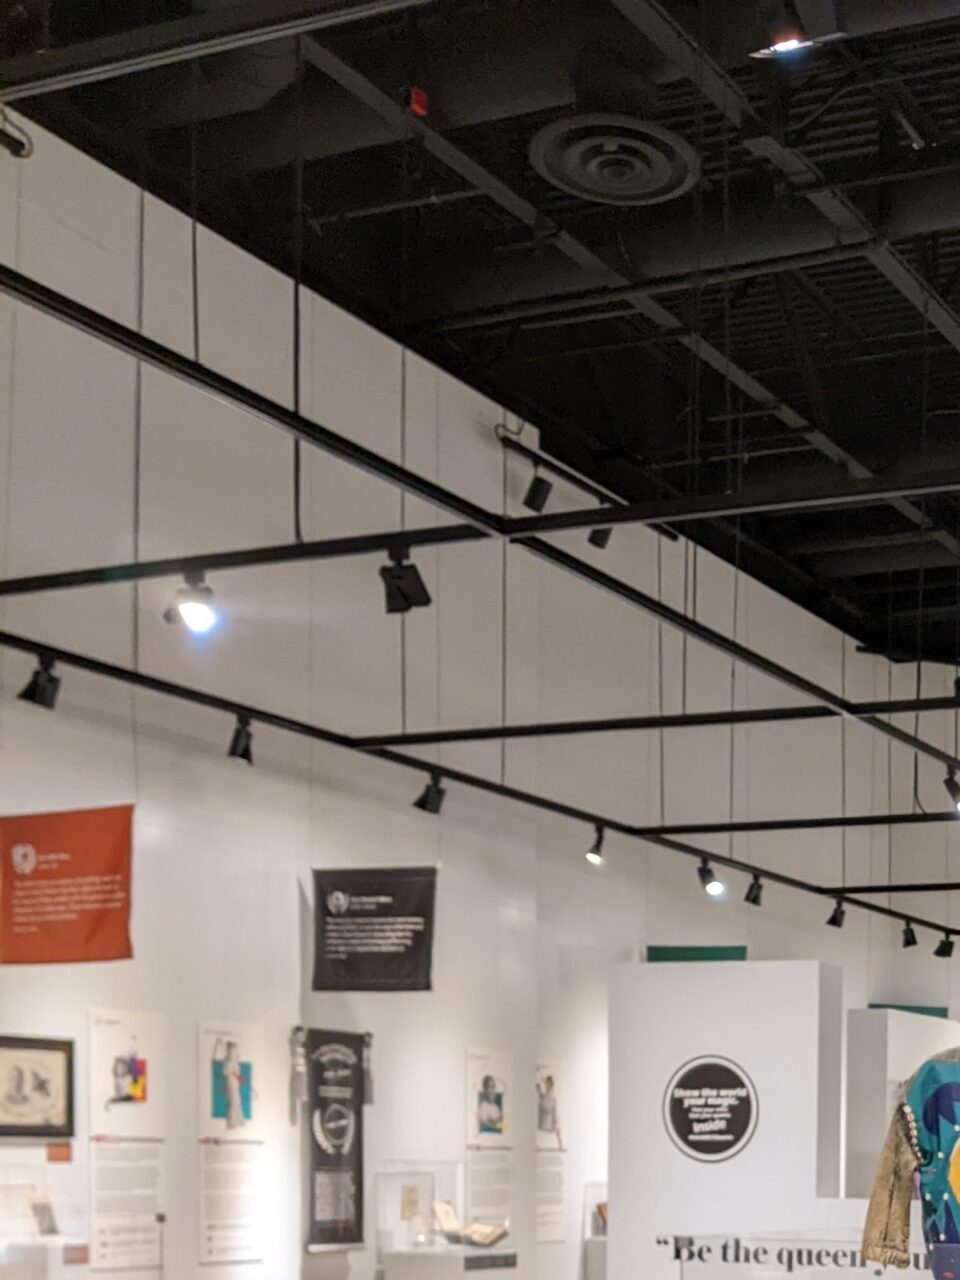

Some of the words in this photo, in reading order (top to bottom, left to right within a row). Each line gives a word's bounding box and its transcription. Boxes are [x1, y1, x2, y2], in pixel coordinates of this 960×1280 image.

[701, 1087, 717, 1097] the
[719, 1087, 747, 1097] world
[721, 1237, 769, 1264] the
